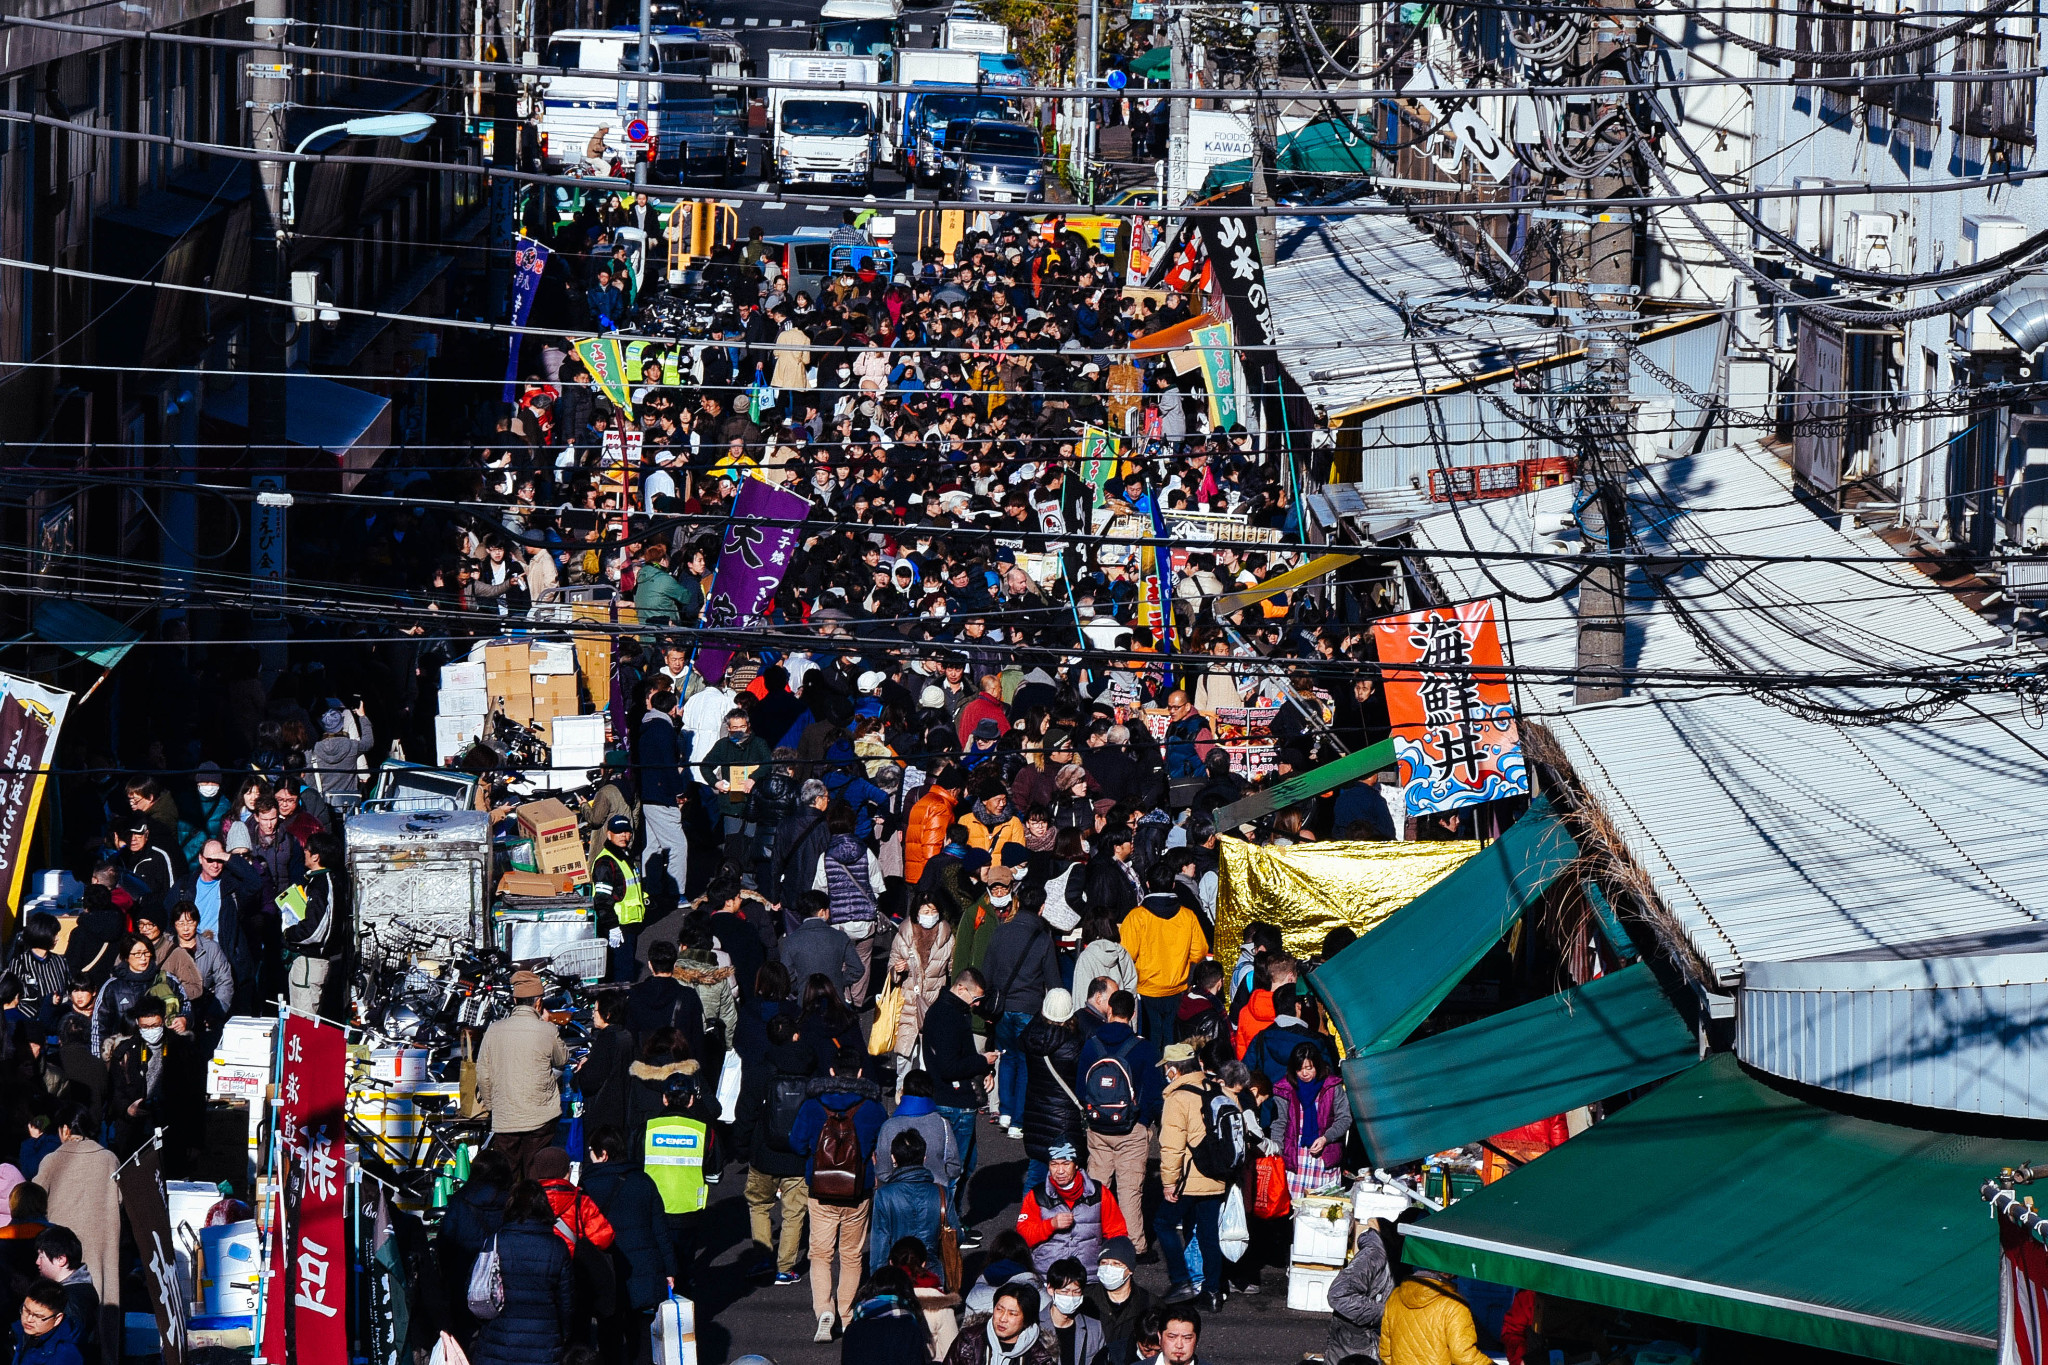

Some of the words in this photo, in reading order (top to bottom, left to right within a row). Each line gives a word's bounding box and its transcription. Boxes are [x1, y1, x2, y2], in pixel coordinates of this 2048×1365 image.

[1215, 132, 1245, 141] FOODS
[606, 433, 641, 442] 列の後尾
[1408, 611, 1490, 783] 海鮮丼
[552, 861, 582, 874] 運行専用
[285, 1034, 303, 1143] 北海道
[246, 1298, 255, 1309] 5
